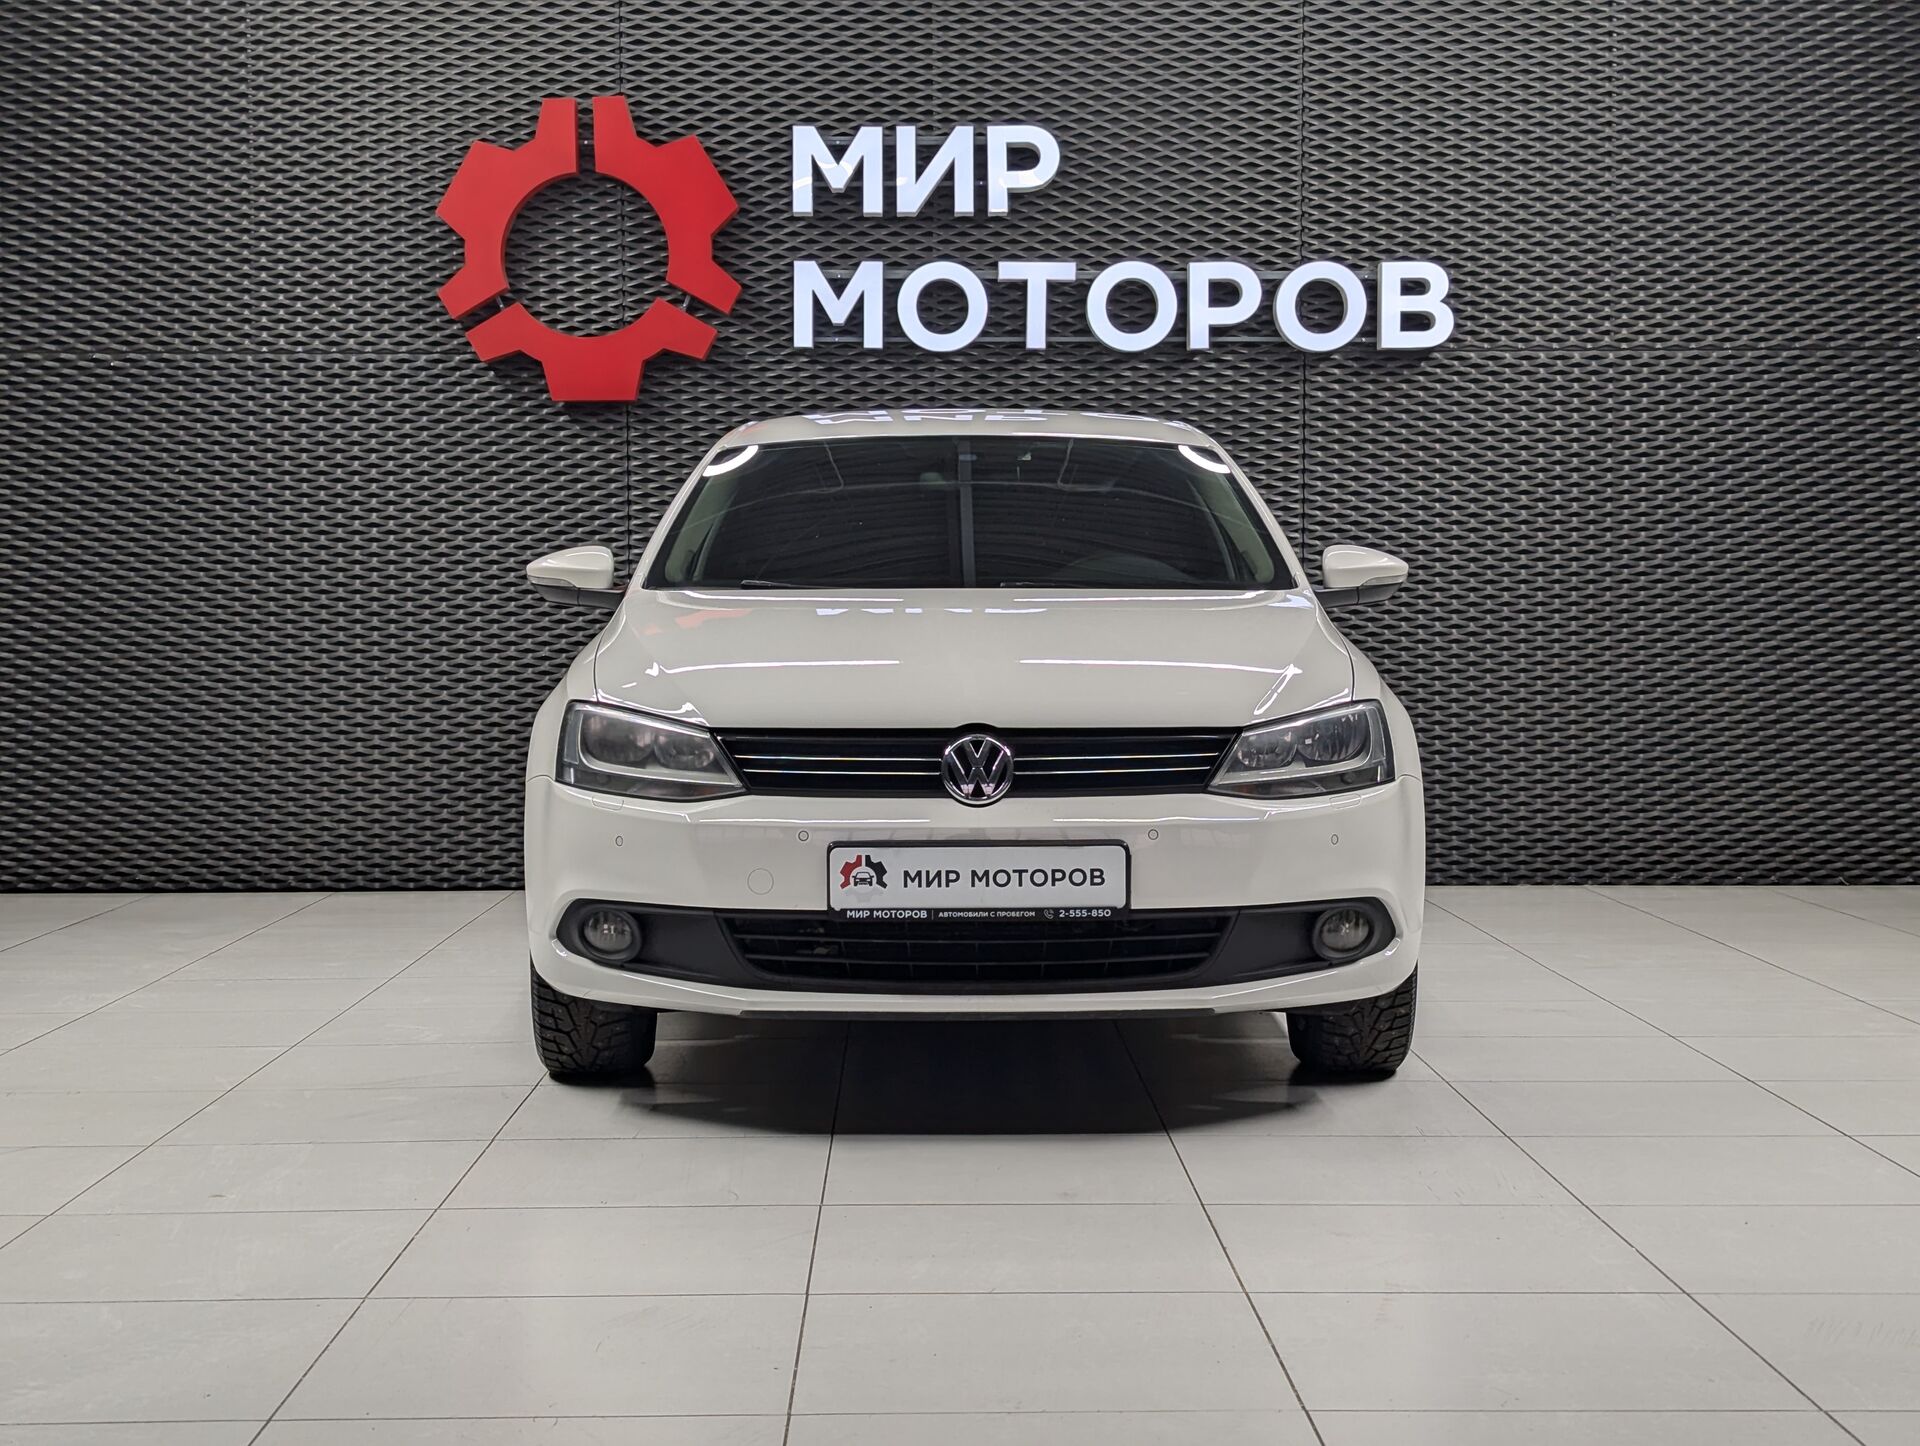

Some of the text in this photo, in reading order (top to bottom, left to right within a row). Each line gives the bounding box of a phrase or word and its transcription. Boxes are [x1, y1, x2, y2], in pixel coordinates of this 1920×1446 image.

[791, 125, 1060, 217] МИР
[791, 260, 1455, 352] МОТОРОВ
[903, 868, 1106, 888] МИР МОТОРОВ
[846, 910, 870, 919] МИР
[873, 910, 928, 919] МОТОРОВ
[1059, 909, 1112, 918] 2-555-850
